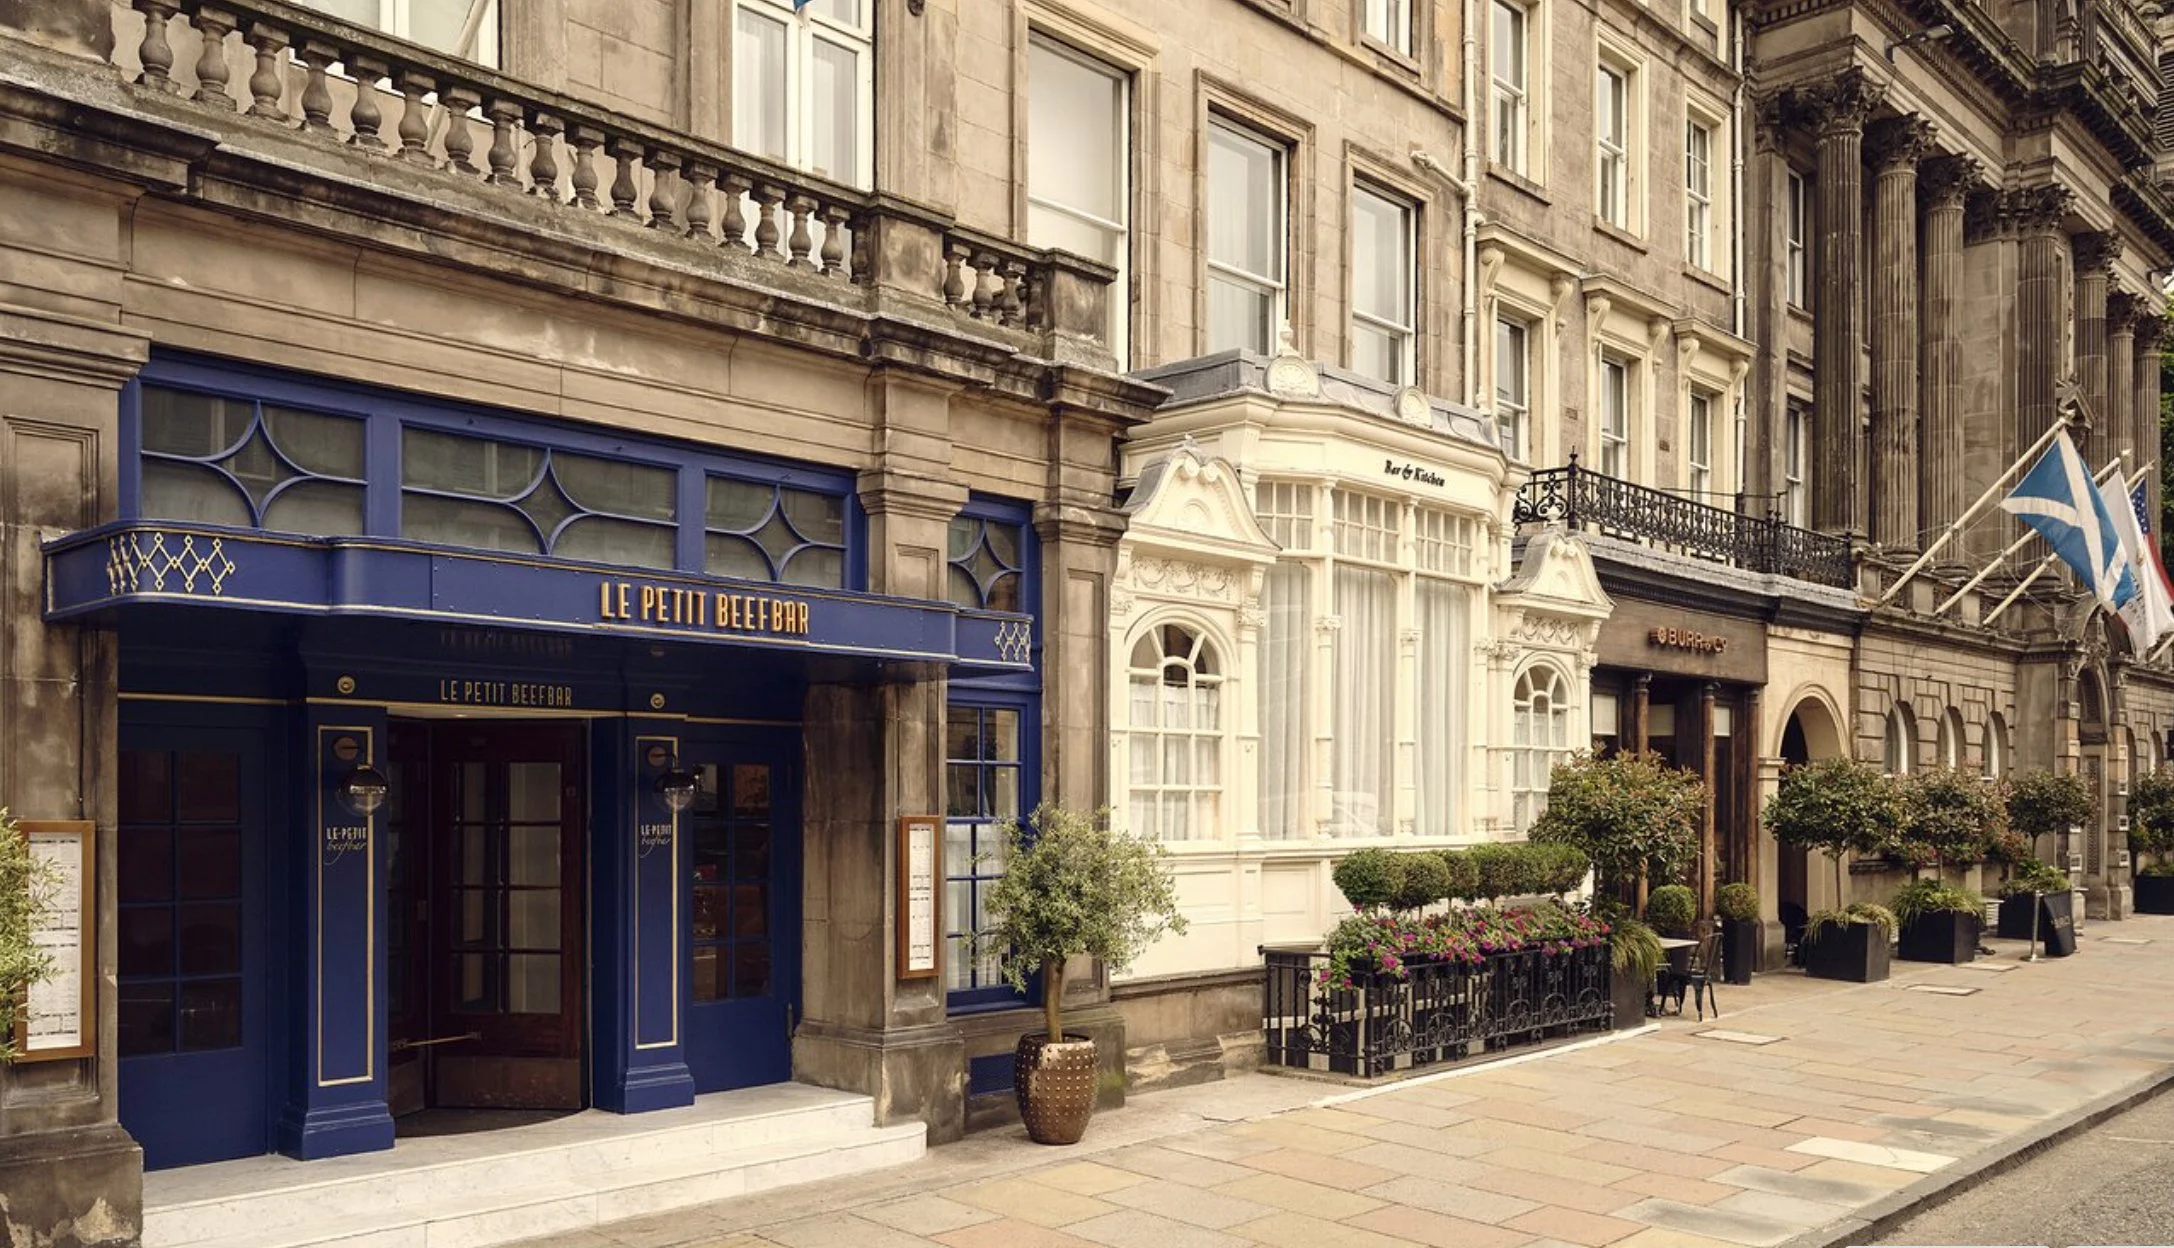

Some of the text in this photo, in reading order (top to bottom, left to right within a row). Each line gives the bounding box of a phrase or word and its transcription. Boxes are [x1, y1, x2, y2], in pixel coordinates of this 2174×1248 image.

[1384, 459, 1445, 487] Bar & Kitchen
[601, 581, 809, 634] LE PETIT BEEFBAR
[1668, 627, 1703, 650] BURR
[440, 679, 573, 707] LE PETIT BEEFBAR
